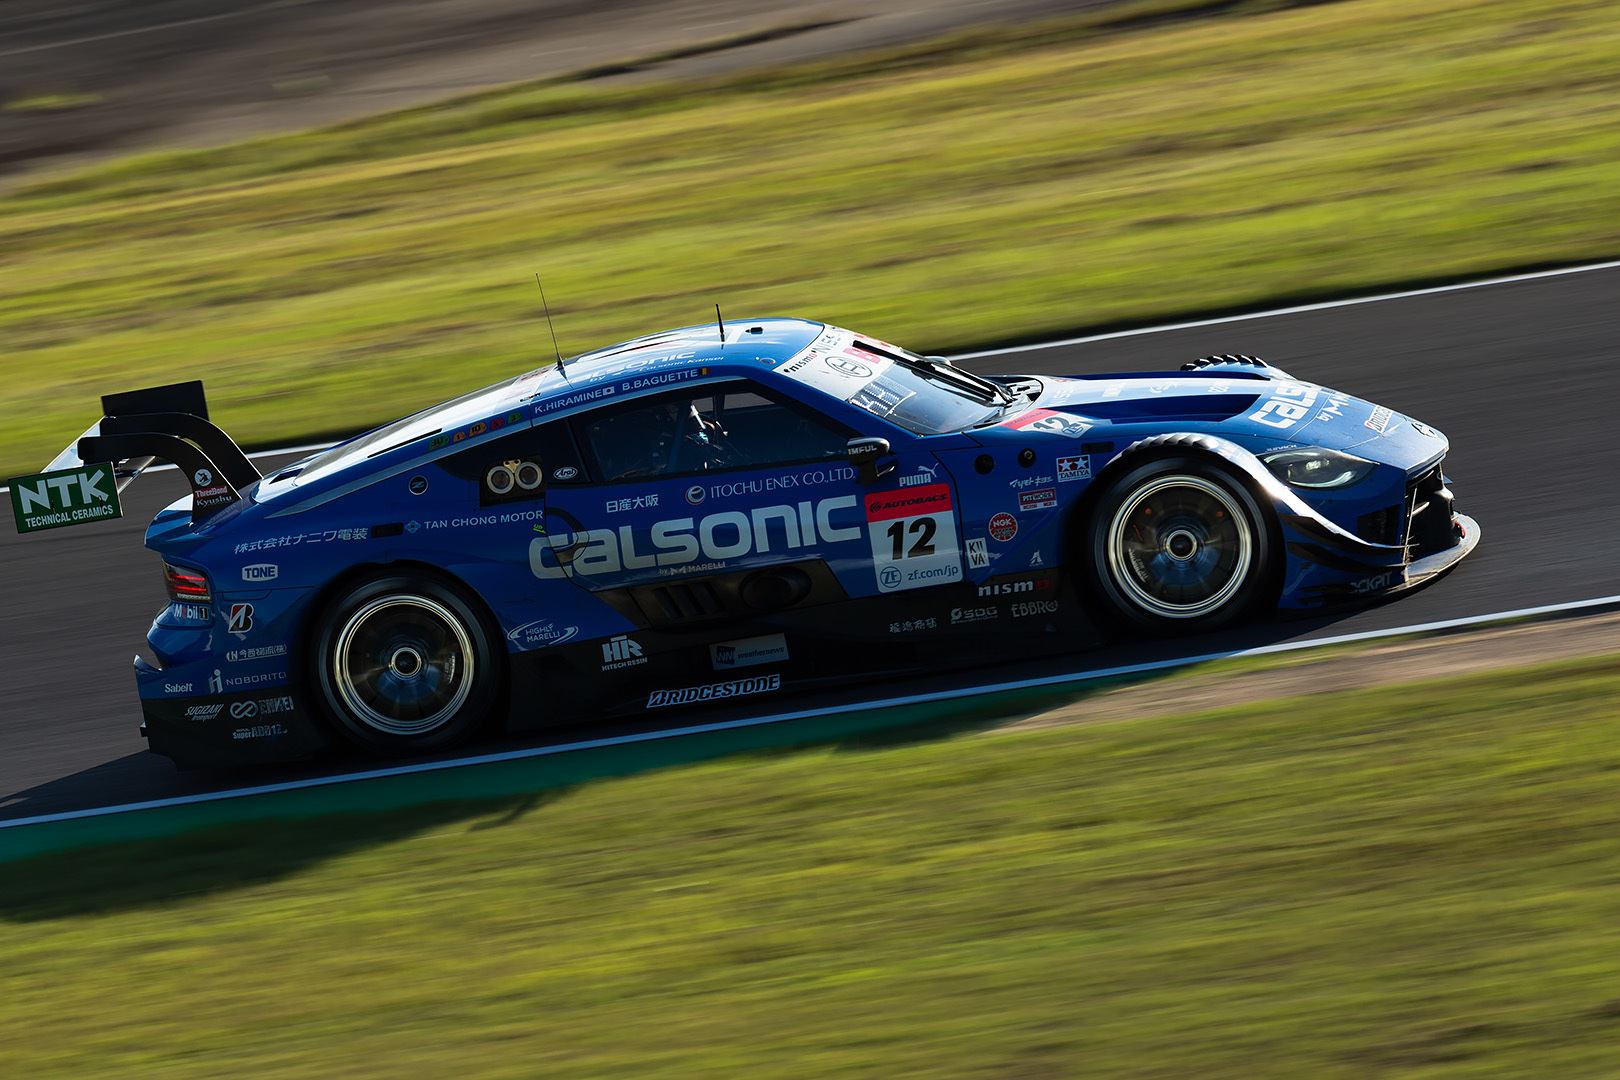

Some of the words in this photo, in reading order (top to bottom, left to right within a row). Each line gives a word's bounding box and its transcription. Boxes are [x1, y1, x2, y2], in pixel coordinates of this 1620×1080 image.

[622, 369, 698, 391] B.BAGUETTE
[534, 389, 603, 414] K.HIRAMINE
[899, 473, 932, 487] PUMA
[1058, 469, 1091, 479] TAMIYA
[17, 469, 109, 514] NTK
[195, 486, 228, 498] ThreeBond
[710, 480, 763, 499] ITOCHU
[765, 474, 799, 492] ENEX
[196, 494, 233, 508] Kyushu
[606, 493, 659, 514] 日産大阪
[883, 493, 947, 510] AUTOBACS
[25, 510, 71, 528] TECHNICAL
[72, 504, 114, 521] CERAMICS
[423, 518, 448, 530] TAN
[451, 514, 497, 528] CHONG
[500, 509, 544, 524] MOTOR
[992, 518, 1012, 528] NGK
[233, 528, 368, 555] 株式会社ナニワ電装
[887, 516, 937, 560] 12
[244, 566, 276, 580] TONE
[659, 567, 668, 576] by
[688, 562, 726, 573] MARELLI
[908, 565, 959, 582] zf.com/jp
[977, 579, 1050, 597] nismo
[174, 603, 198, 620] Mobil
[525, 623, 554, 636] HIGHLY
[526, 631, 561, 643] MARELLI
[737, 647, 785, 659] weathernews
[601, 661, 626, 671] HITECH
[627, 657, 648, 668] RESIN
[226, 671, 287, 686] NOBORITO
[164, 682, 193, 694] Sabelt
[646, 673, 781, 709] BRIDGESTONE
[184, 703, 225, 716] SUGIZAKI
